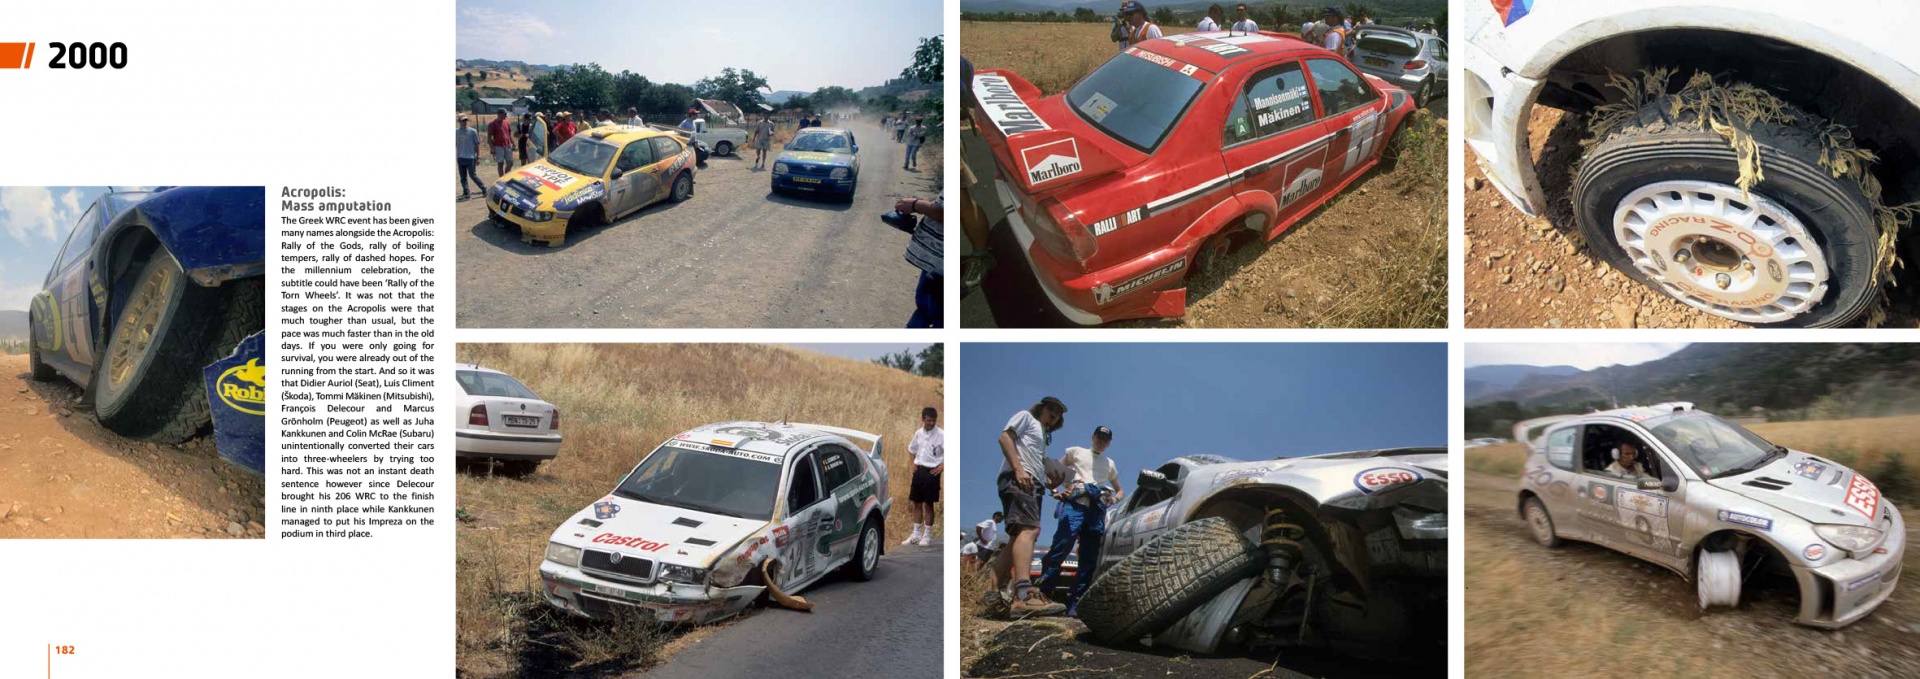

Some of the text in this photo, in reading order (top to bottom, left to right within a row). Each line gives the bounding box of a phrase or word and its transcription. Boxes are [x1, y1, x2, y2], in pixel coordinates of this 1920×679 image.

[49, 42, 127, 69] 2000
[1136, 50, 1177, 67] MITSUBISHI
[1253, 86, 1299, 111] Mannisenmäki
[979, 77, 1045, 136] Marlboro
[1257, 104, 1301, 127] Mäkinen
[1031, 162, 1080, 183] Marlboro
[541, 173, 567, 186] YPF
[281, 186, 345, 199] Acropolis:
[617, 189, 626, 202] 7
[1281, 174, 1321, 208] Marlboro
[281, 200, 391, 213] Mass amputation
[281, 216, 297, 224] The
[412, 217, 434, 226] given
[1094, 208, 1141, 237] RALLI ART
[1649, 215, 1706, 237] RACING
[336, 229, 375, 238] alongside
[393, 229, 434, 238] Acropolis:
[282, 242, 301, 251] Rally
[340, 242, 363, 250] Gods,
[369, 242, 387, 251] rally
[406, 242, 434, 251] boiling
[281, 255, 318, 263] tempers,
[322, 254, 340, 263] rally
[389, 254, 417, 263] hopes.
[281, 266, 295, 274] the
[305, 266, 351, 274] millennium
[361, 266, 411, 275] celebration,
[1116, 261, 1183, 294] MICHELIN
[1716, 292, 1775, 308] RACING
[281, 305, 307, 314] stages
[328, 304, 342, 312] the
[347, 304, 386, 313] Acropolis
[417, 304, 434, 312] that
[282, 316, 304, 324] much
[310, 316, 343, 326] tougher
[372, 317, 396, 325] usual,
[281, 342, 302, 351] days.
[369, 342, 387, 351] only
[393, 342, 416, 351] going
[281, 379, 298, 387] that
[301, 379, 326, 387] Didier
[327, 379, 352, 387] Auriol
[355, 379, 381, 388] (Seat),
[402, 379, 434, 387] Climent
[224, 383, 265, 401] Rob
[281, 391, 434, 401] (Škoda), Tommi Mäkinen (Mitsubishi),
[282, 405, 316, 414] François
[327, 404, 365, 412] Delecour
[376, 404, 392, 412] and
[281, 417, 323, 425] Grönholm
[327, 417, 367, 427] (Peugeot)
[383, 417, 399, 425] well
[415, 417, 434, 425] Juha
[400, 429, 434, 438] (Subaru)
[282, 442, 344, 451] unintentionally
[374, 455, 384, 464] by
[389, 455, 414, 464] trying
[282, 492, 314, 501] brought
[319, 492, 331, 500] his
[335, 492, 351, 500] 206
[355, 492, 376, 500] WRC
[393, 492, 407, 500] the
[412, 492, 434, 500] finish
[282, 505, 296, 513] line
[311, 505, 333, 513] ninth
[337, 505, 359, 514] place
[362, 505, 385, 513] while
[388, 505, 434, 513] Kankkunen
[282, 530, 313, 539] podium
[348, 530, 372, 539] place.
[592, 532, 670, 552] Castrol
[56, 646, 74, 654] 182
